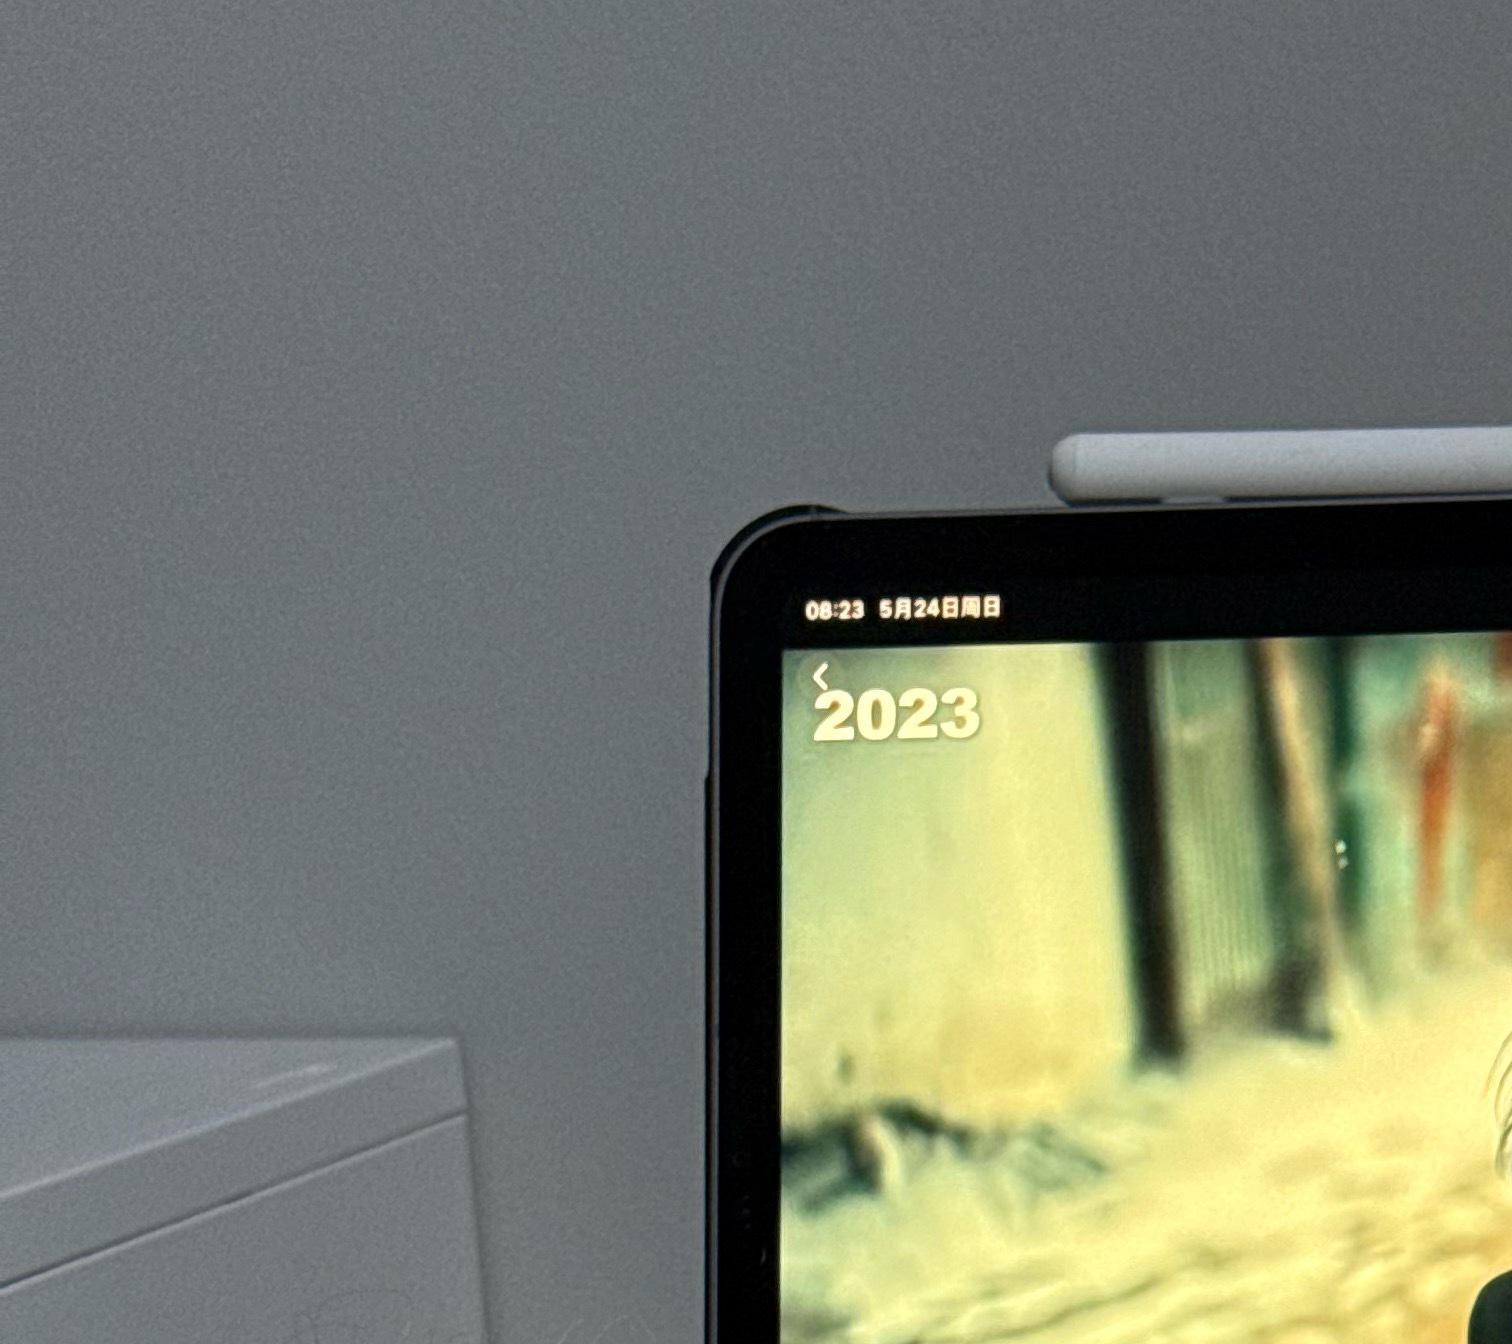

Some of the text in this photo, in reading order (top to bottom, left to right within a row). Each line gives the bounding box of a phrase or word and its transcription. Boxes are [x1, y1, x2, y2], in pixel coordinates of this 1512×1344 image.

[805, 594, 1001, 621] 08:23 5月24日周日
[813, 687, 981, 742] 2023
